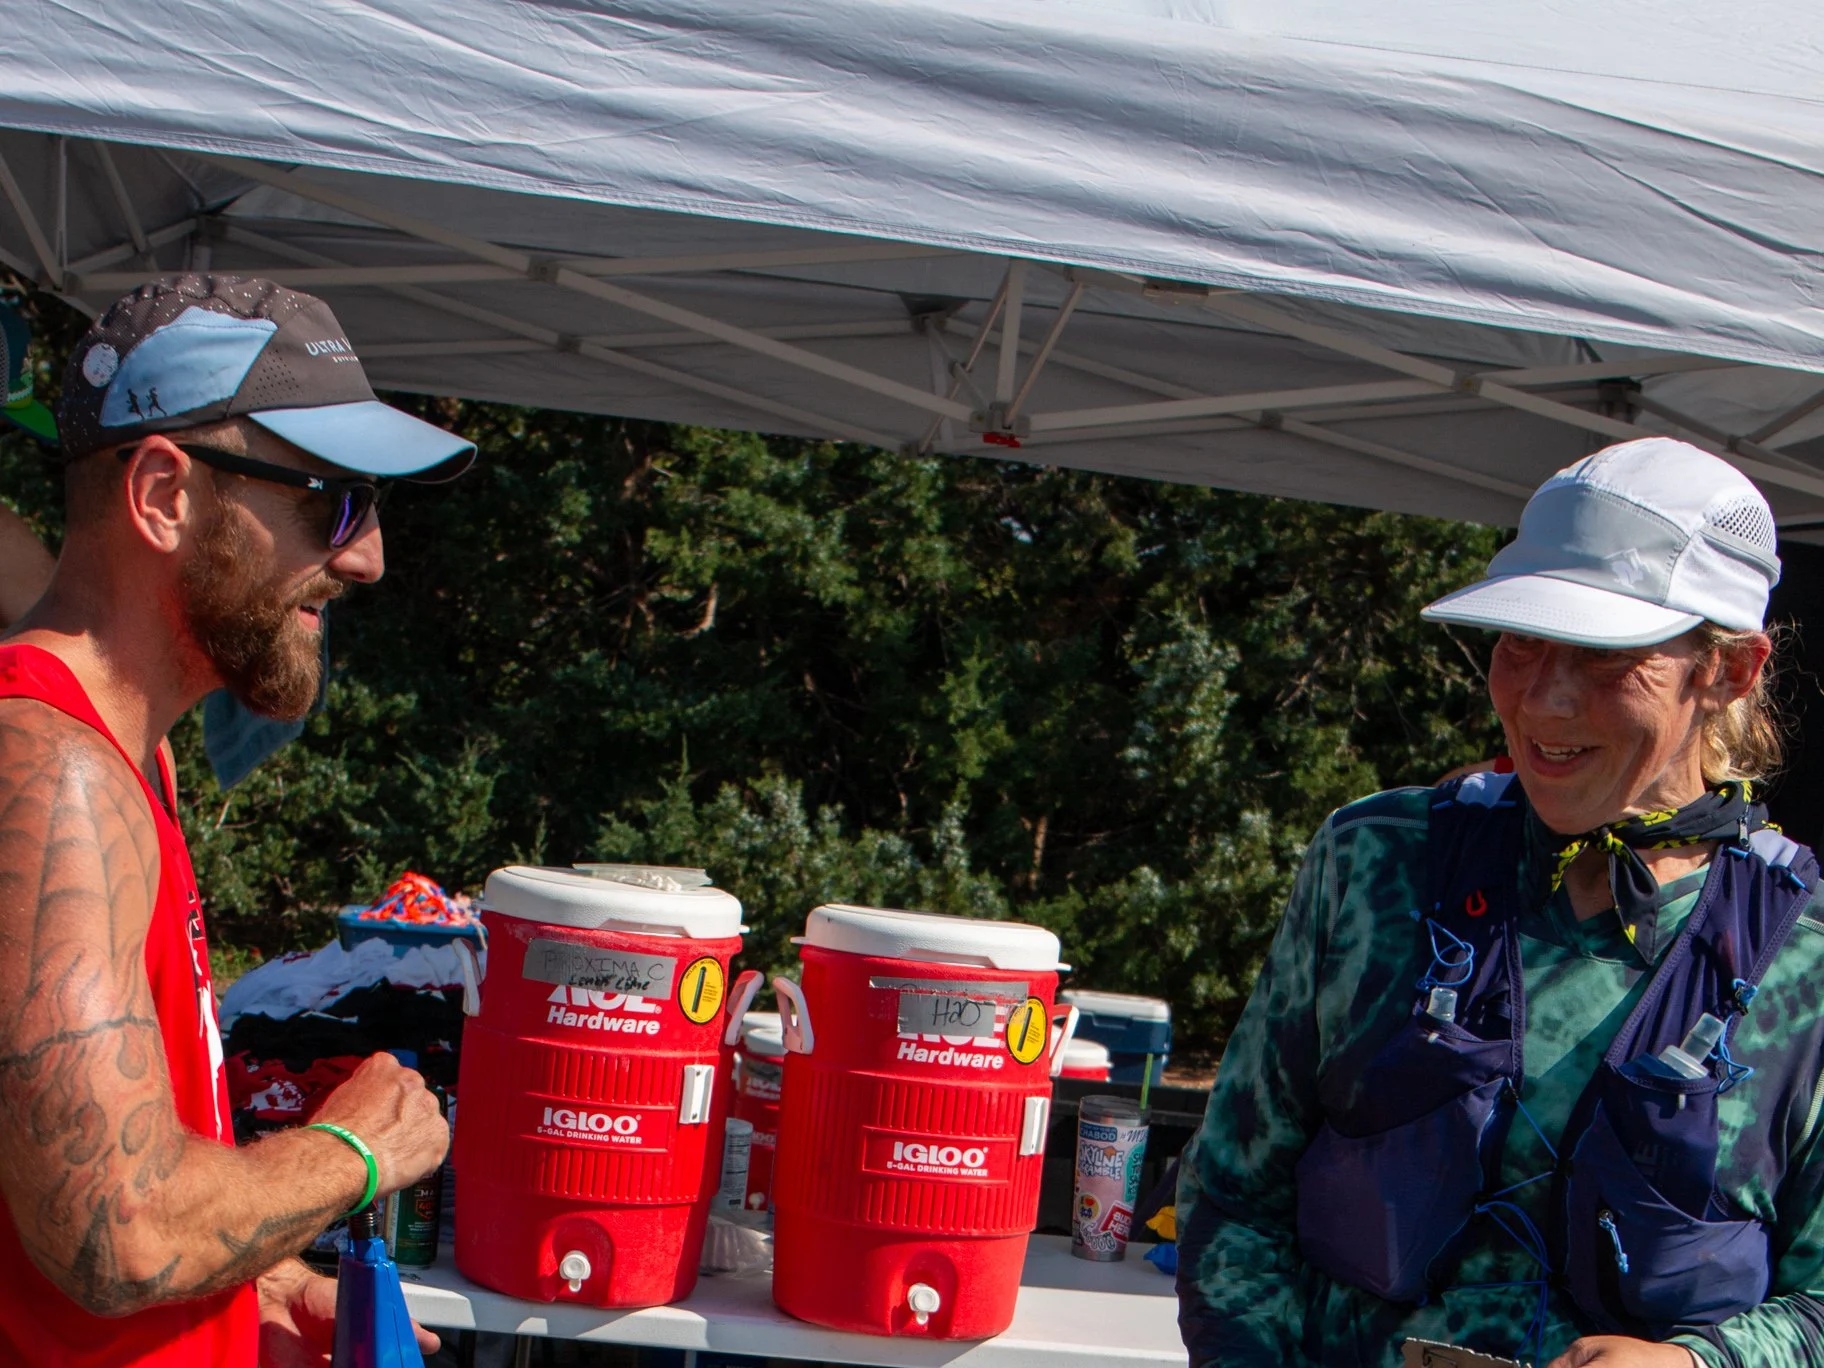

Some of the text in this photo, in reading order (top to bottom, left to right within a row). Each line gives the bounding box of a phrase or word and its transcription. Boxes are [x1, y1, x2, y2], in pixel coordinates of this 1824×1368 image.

[305, 339, 346, 356] ULTRA
[647, 962, 666, 981] C
[547, 1005, 660, 1035] Hardware
[897, 1042, 1004, 1069] Hardware
[543, 1106, 639, 1135] IGLOO
[566, 1130, 610, 1142] DRINKING
[611, 1135, 643, 1144] WATER
[893, 1141, 985, 1168] IGLOO
[917, 1164, 959, 1175] DRINKING
[960, 1168, 988, 1177] WATER
